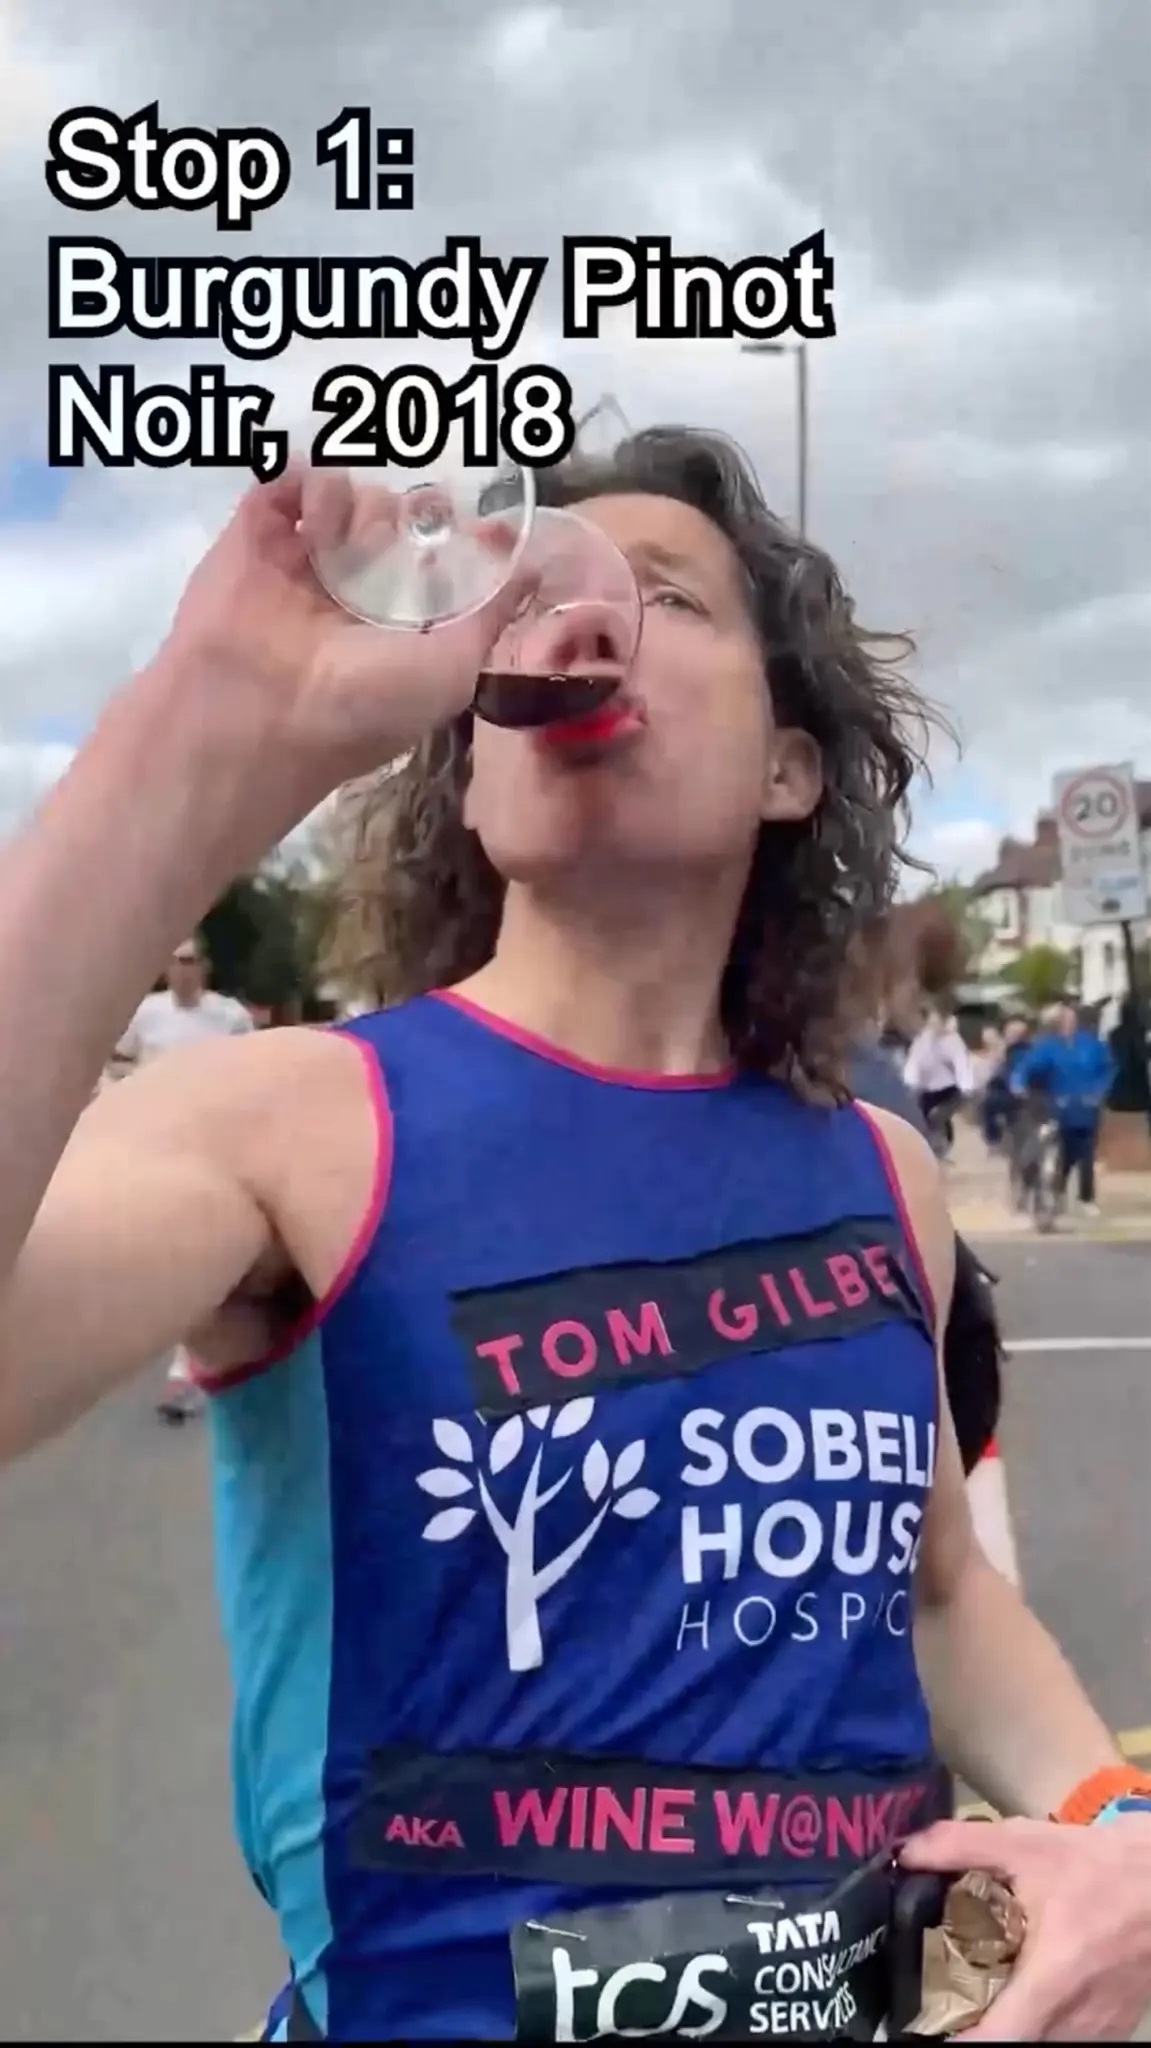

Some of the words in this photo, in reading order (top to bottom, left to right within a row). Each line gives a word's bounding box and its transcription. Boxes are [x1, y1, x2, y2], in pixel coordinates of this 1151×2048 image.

[1075, 790, 1118, 822] 20
[476, 1301, 676, 1395] TOM
[680, 1499, 923, 1584] HOUS
[384, 1813, 466, 1849] AKA
[493, 1786, 696, 1854] WINE
[746, 1910, 841, 1954] TATA
[552, 1947, 729, 2042] tcs
